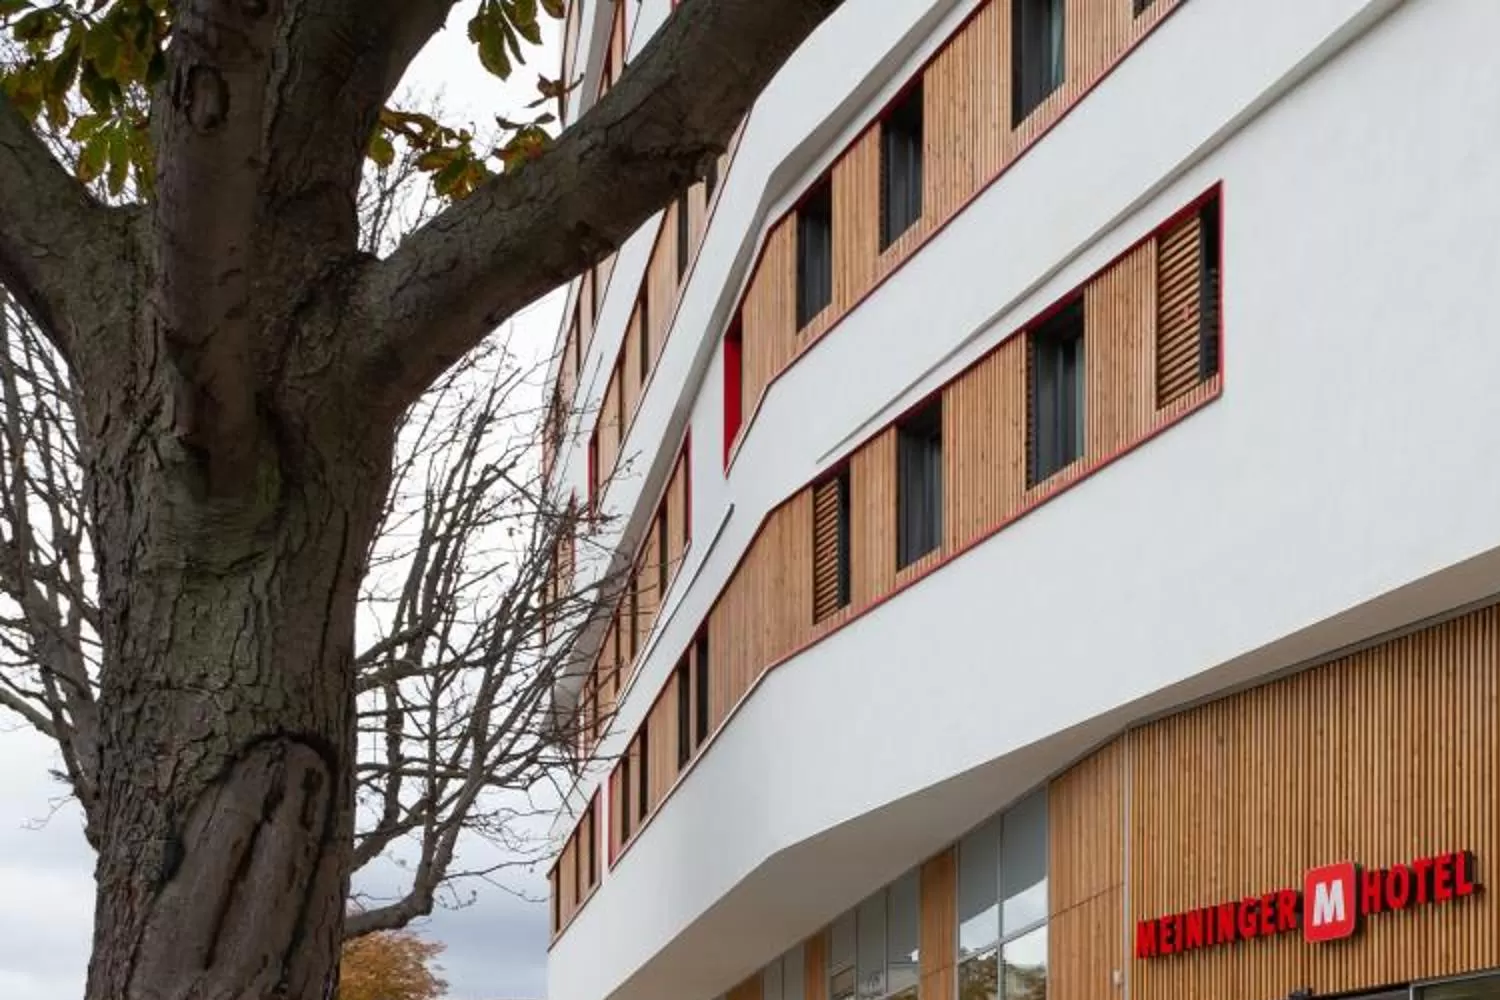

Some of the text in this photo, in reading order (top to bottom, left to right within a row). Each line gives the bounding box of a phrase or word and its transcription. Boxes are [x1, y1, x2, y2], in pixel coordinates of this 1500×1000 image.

[1136, 849, 1473, 959] MEININGER M HOTEL
